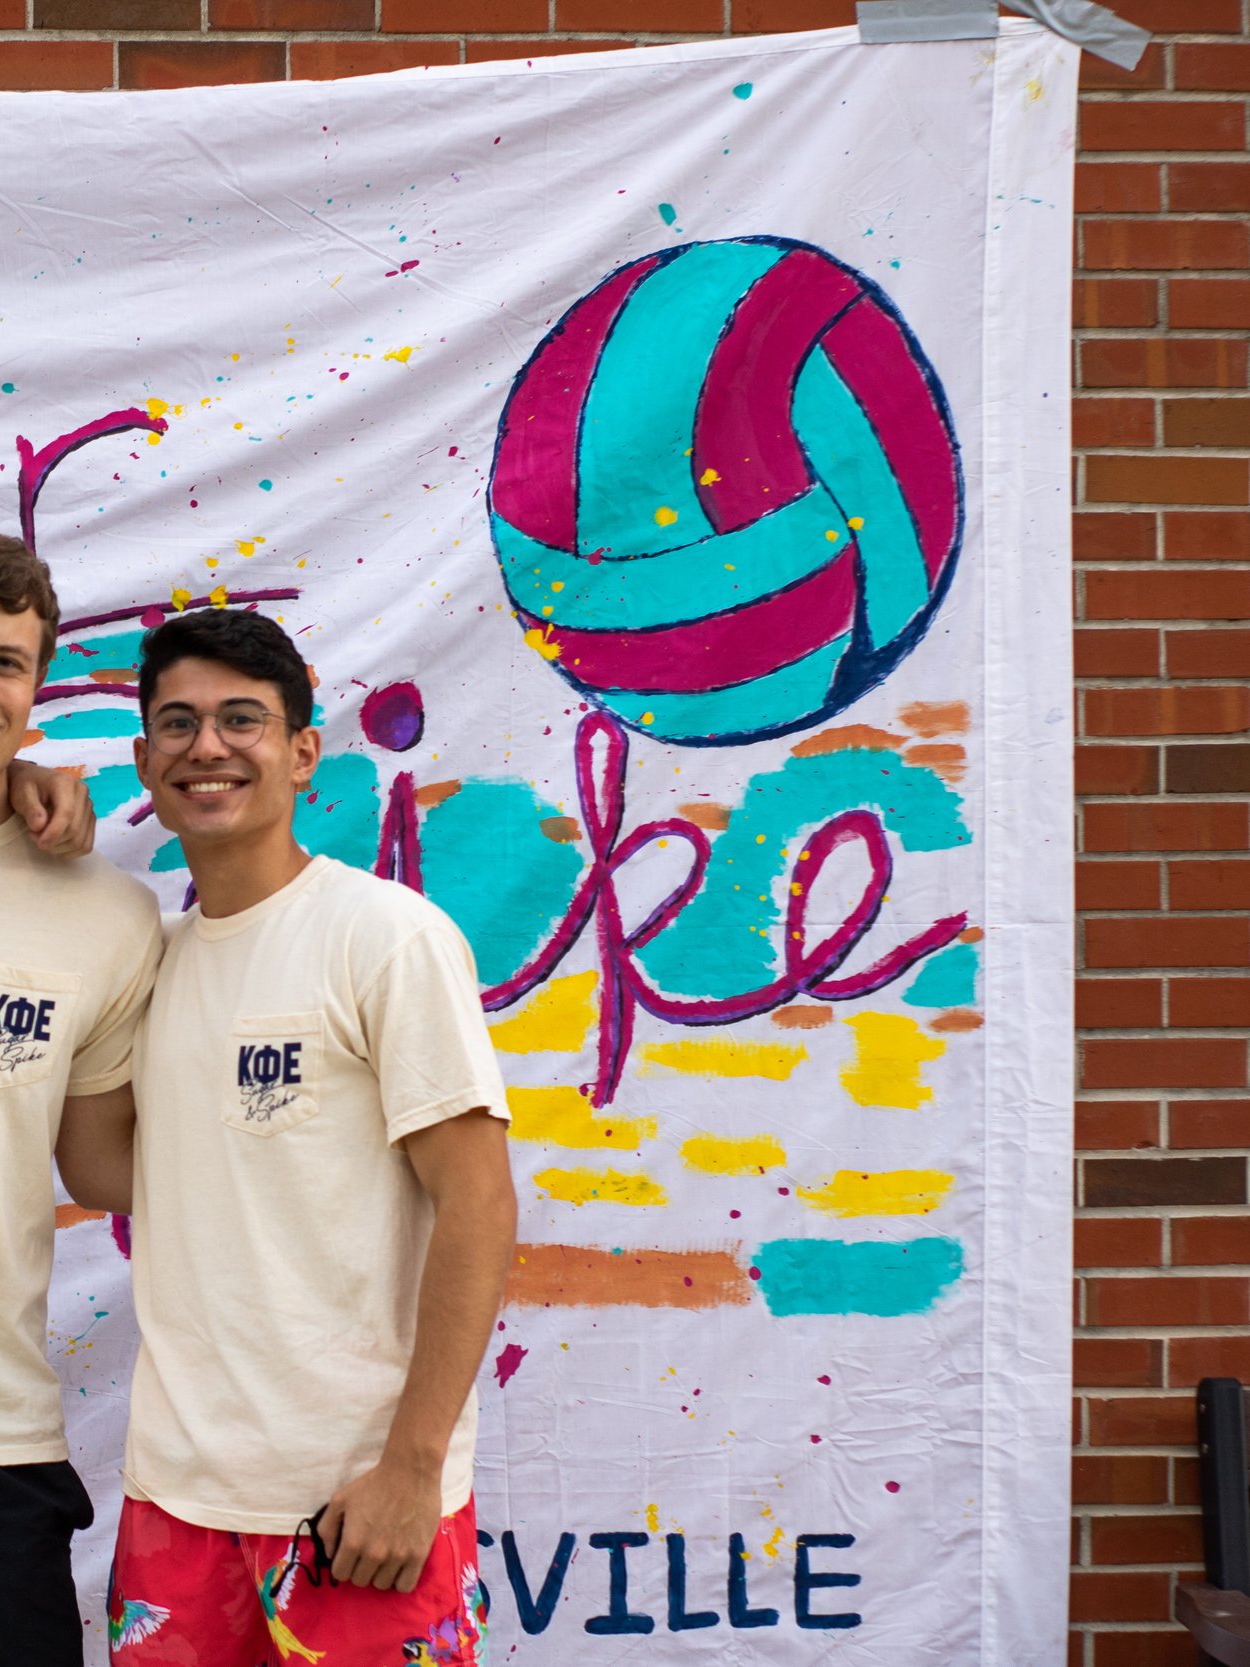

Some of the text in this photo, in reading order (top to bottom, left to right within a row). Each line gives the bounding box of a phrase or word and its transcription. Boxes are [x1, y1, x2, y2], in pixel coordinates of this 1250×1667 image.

[0, 1046, 47, 1072] Spike
[245, 1105, 256, 1121] &
[476, 1530, 862, 1636] VILLE
